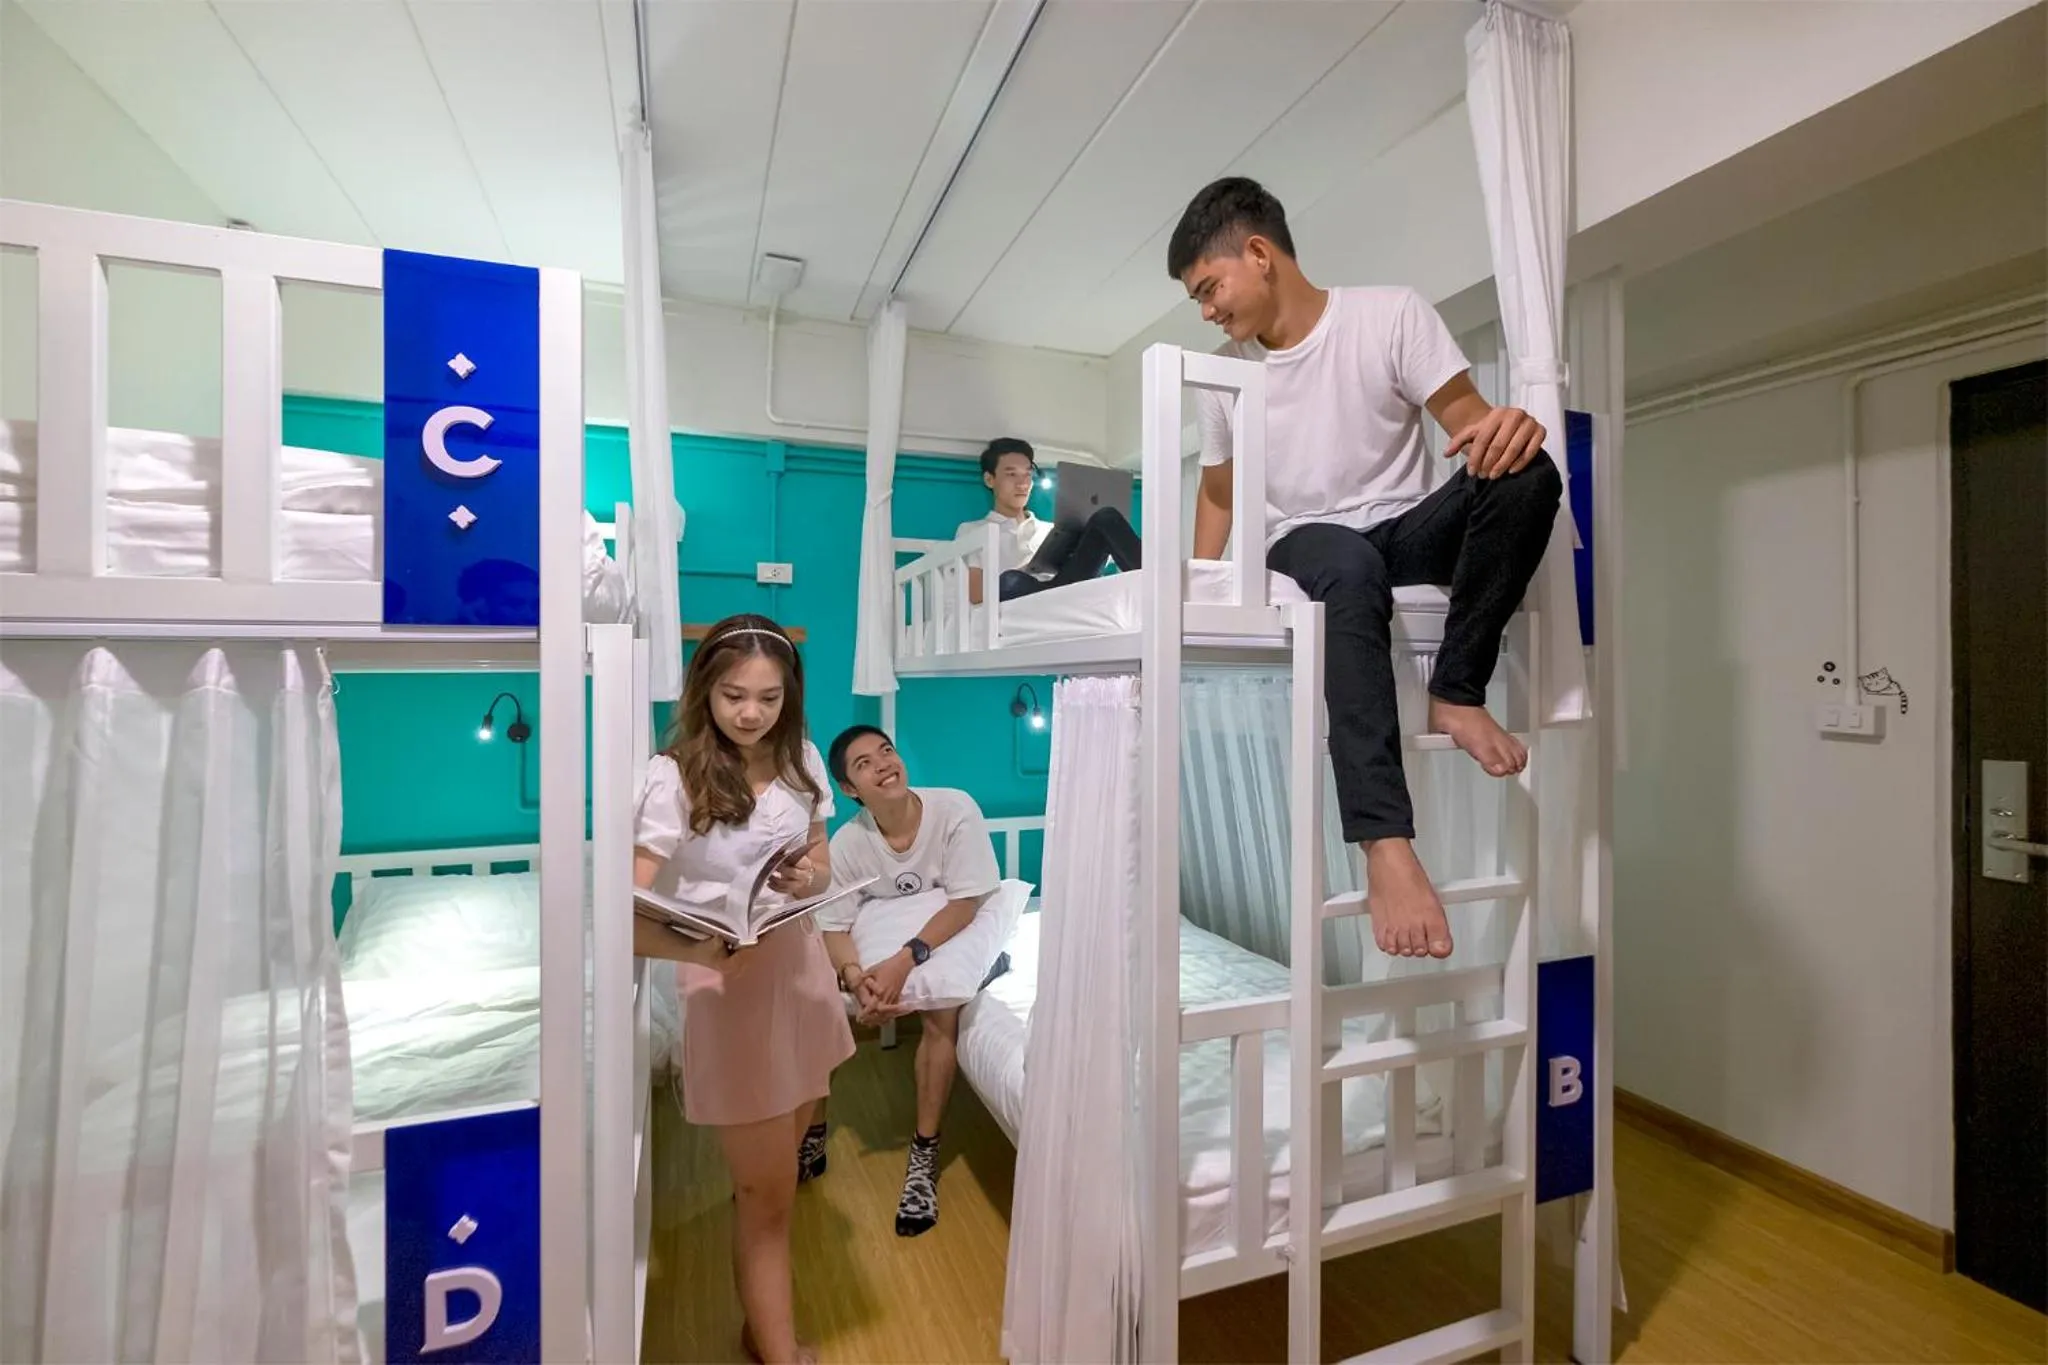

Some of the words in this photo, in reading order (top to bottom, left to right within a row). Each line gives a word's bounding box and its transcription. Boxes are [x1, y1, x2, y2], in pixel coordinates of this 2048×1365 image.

[421, 405, 503, 479] C
[1548, 1055, 1584, 1108] B
[420, 1267, 504, 1355] D
